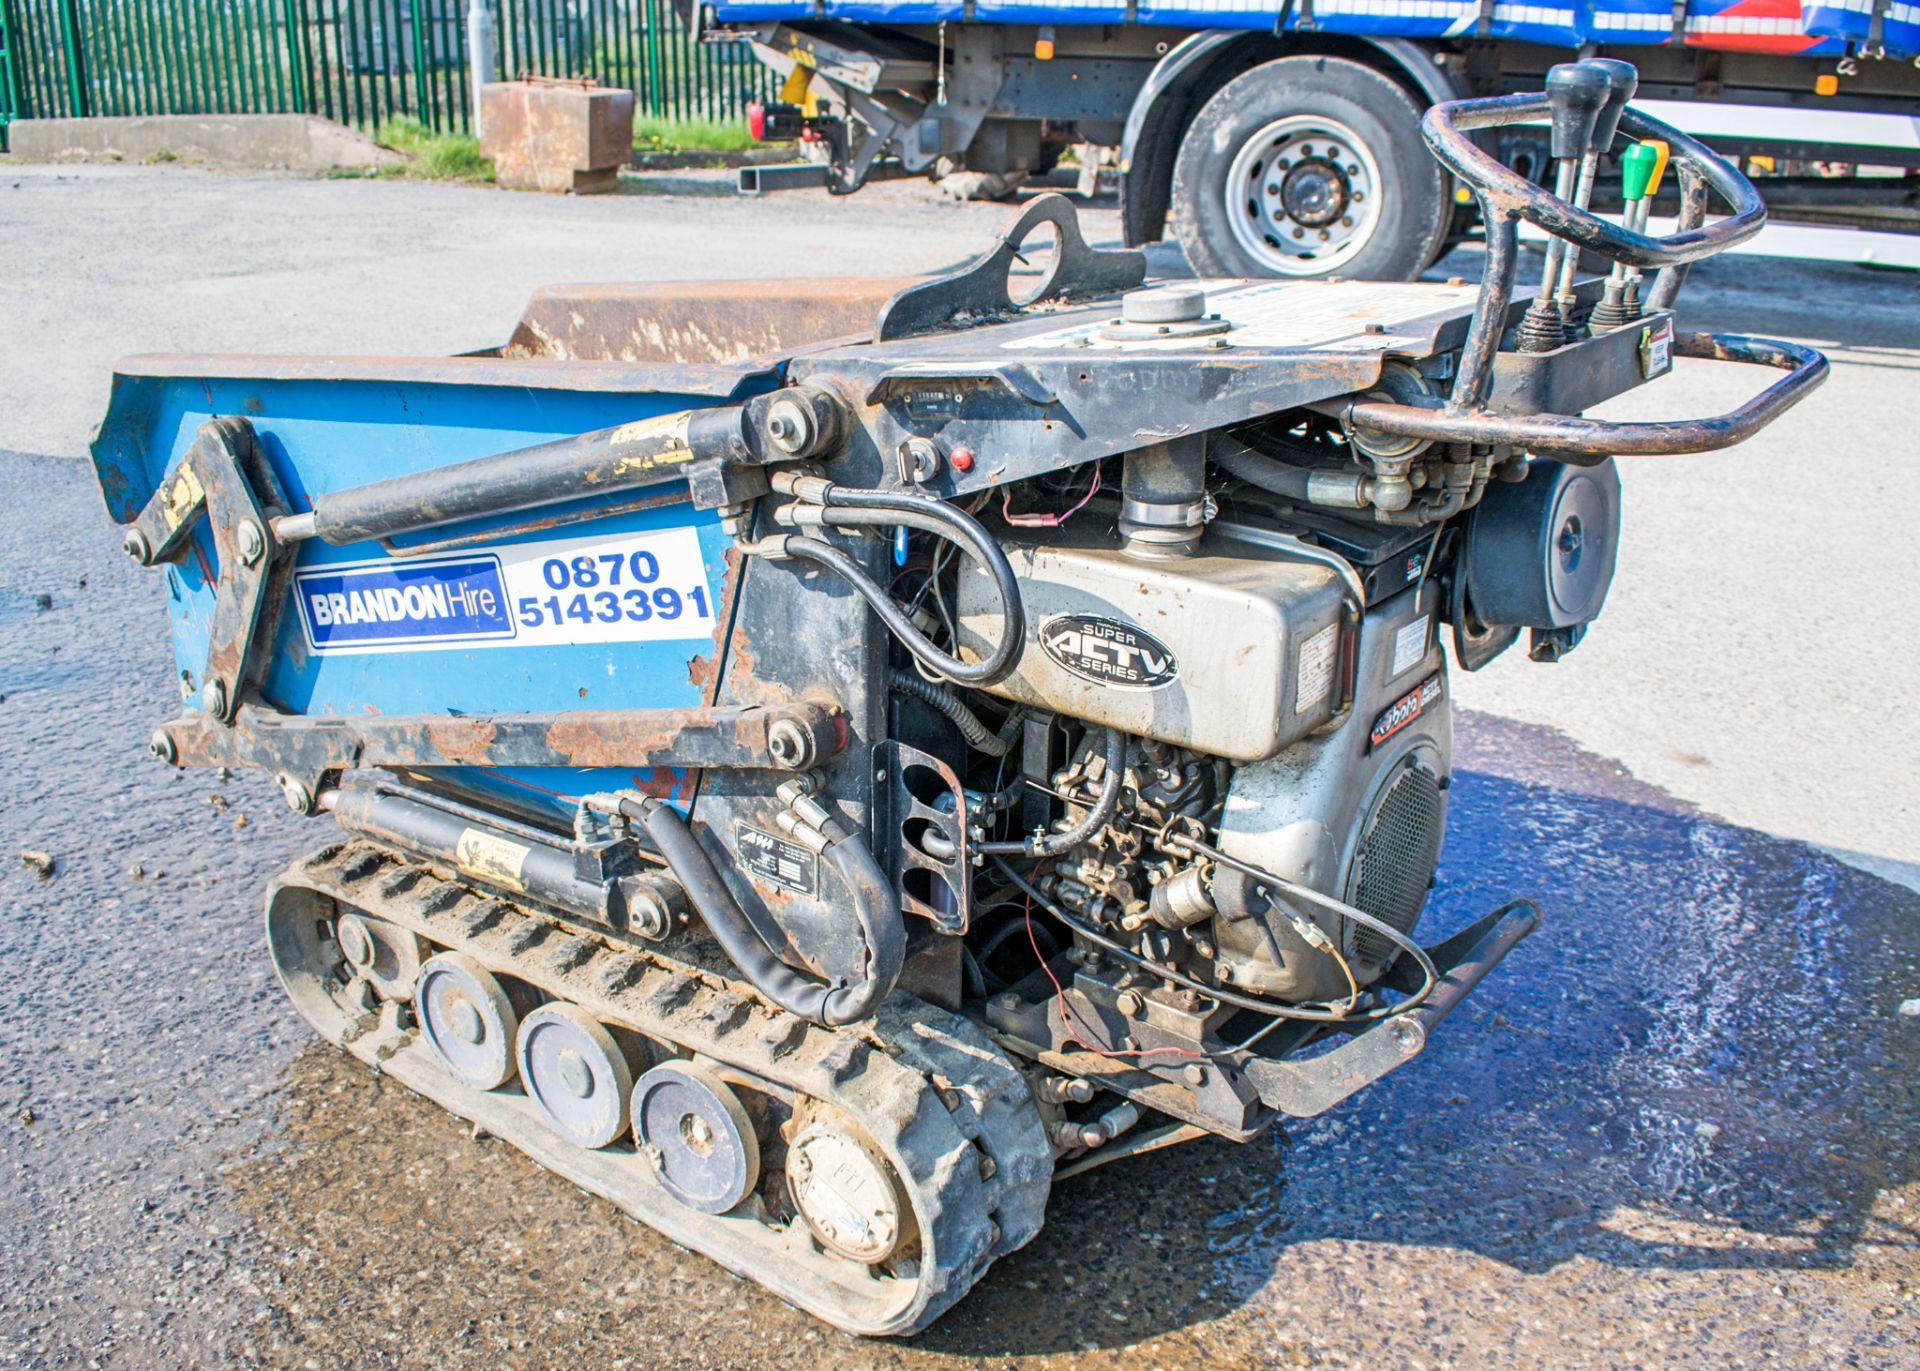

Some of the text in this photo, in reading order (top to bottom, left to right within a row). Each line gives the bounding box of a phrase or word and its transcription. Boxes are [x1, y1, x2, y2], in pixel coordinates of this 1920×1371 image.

[543, 551, 660, 590] 0870
[310, 581, 497, 626] BRANDON Hire
[518, 586, 709, 628] 5143391
[1046, 630, 1173, 676] ACTV
[1083, 624, 1136, 646] SUPER
[1081, 657, 1138, 681] SERIES
